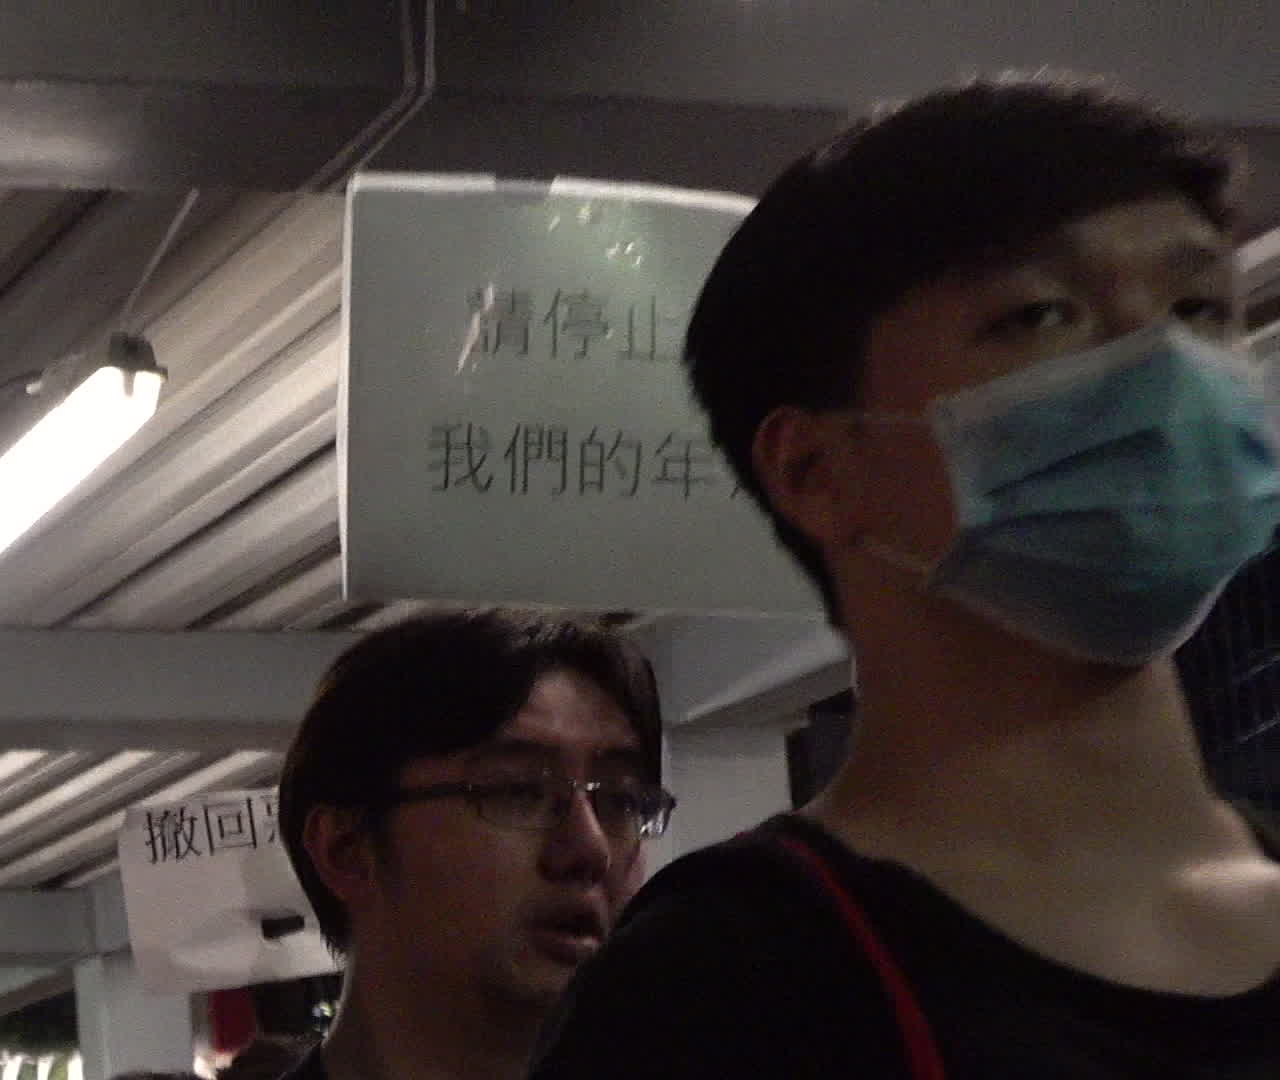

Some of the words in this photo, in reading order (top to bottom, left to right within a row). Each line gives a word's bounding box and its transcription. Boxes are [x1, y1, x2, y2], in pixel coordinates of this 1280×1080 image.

[428, 423, 741, 498] 我們的年
[144, 797, 279, 864] 撤回
